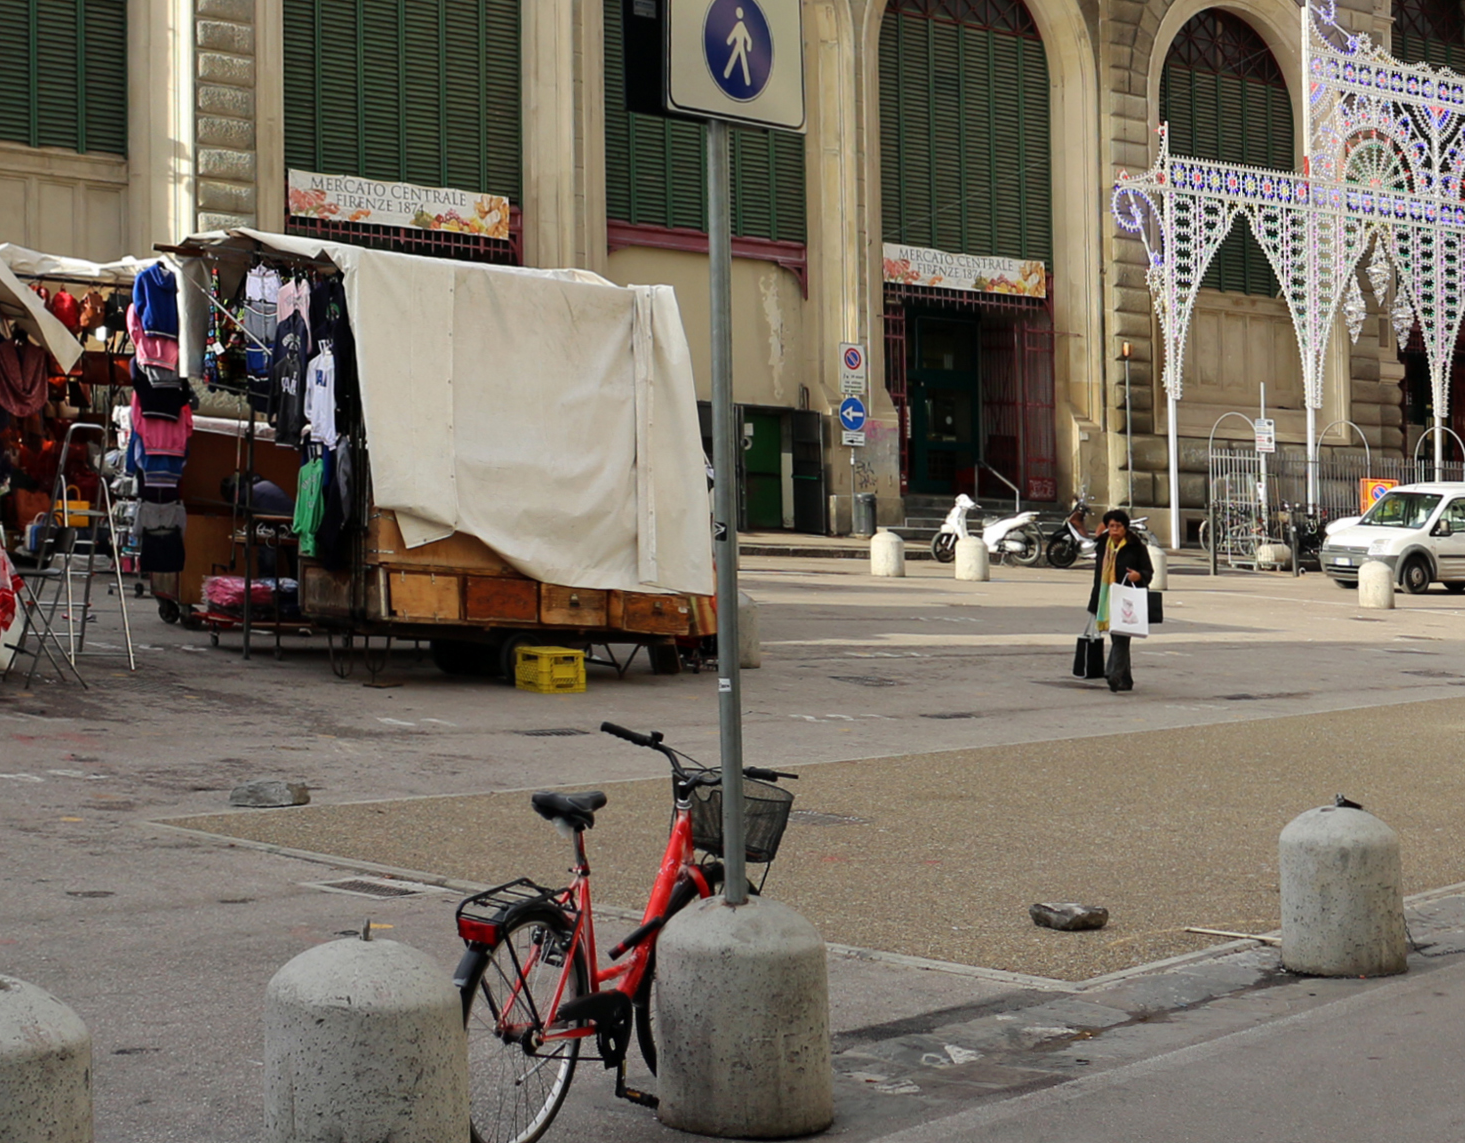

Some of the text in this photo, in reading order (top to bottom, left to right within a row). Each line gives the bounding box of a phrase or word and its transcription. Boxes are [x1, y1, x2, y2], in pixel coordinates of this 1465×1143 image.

[310, 177, 467, 207] MERCATO CENTRALE
[336, 193, 424, 215] FIRENZE 1874
[899, 248, 1013, 272] MERCATO CENTRALE
[917, 263, 983, 280] FIRENZE 1874
